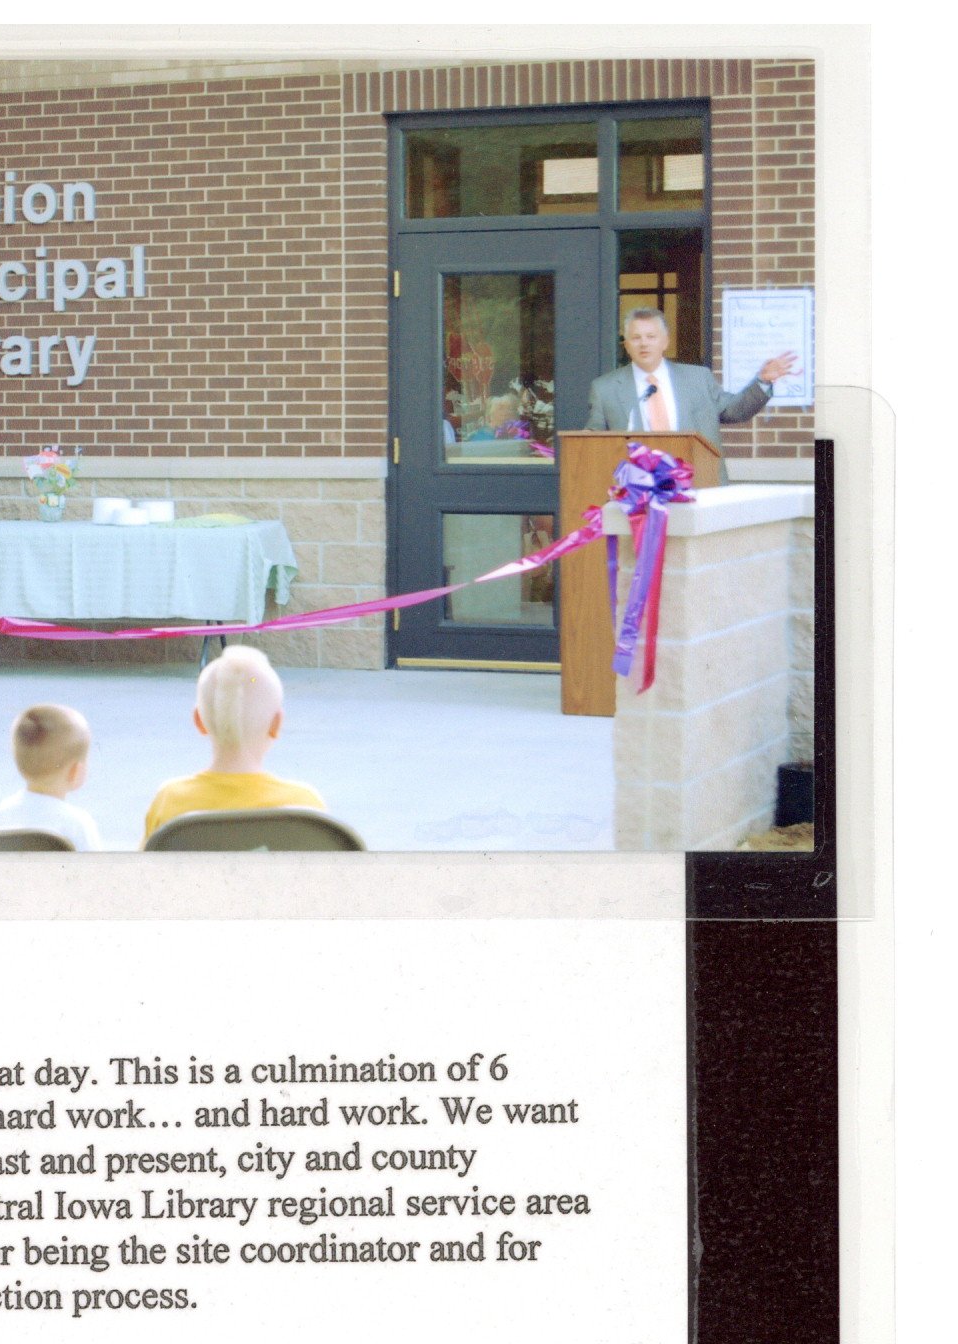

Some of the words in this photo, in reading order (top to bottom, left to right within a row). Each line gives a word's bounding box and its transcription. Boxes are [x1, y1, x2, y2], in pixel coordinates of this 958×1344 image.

[34, 1058, 97, 1093] day.
[110, 1056, 178, 1085] This
[189, 1056, 214, 1084] is
[225, 1064, 242, 1083] a
[252, 1054, 437, 1083] culmination
[447, 1053, 484, 1081] of
[490, 1054, 508, 1081] 6
[55, 1191, 132, 1219] Iowa
[141, 1189, 258, 1226] Library
[268, 1187, 395, 1225] regional
[407, 1186, 515, 1216] service
[526, 1195, 591, 1215] area
[23, 1236, 109, 1272] being
[118, 1235, 166, 1264] the
[177, 1234, 230, 1264] site
[240, 1233, 420, 1263] coordinator
[430, 1232, 486, 1262] and
[496, 1231, 542, 1261] for
